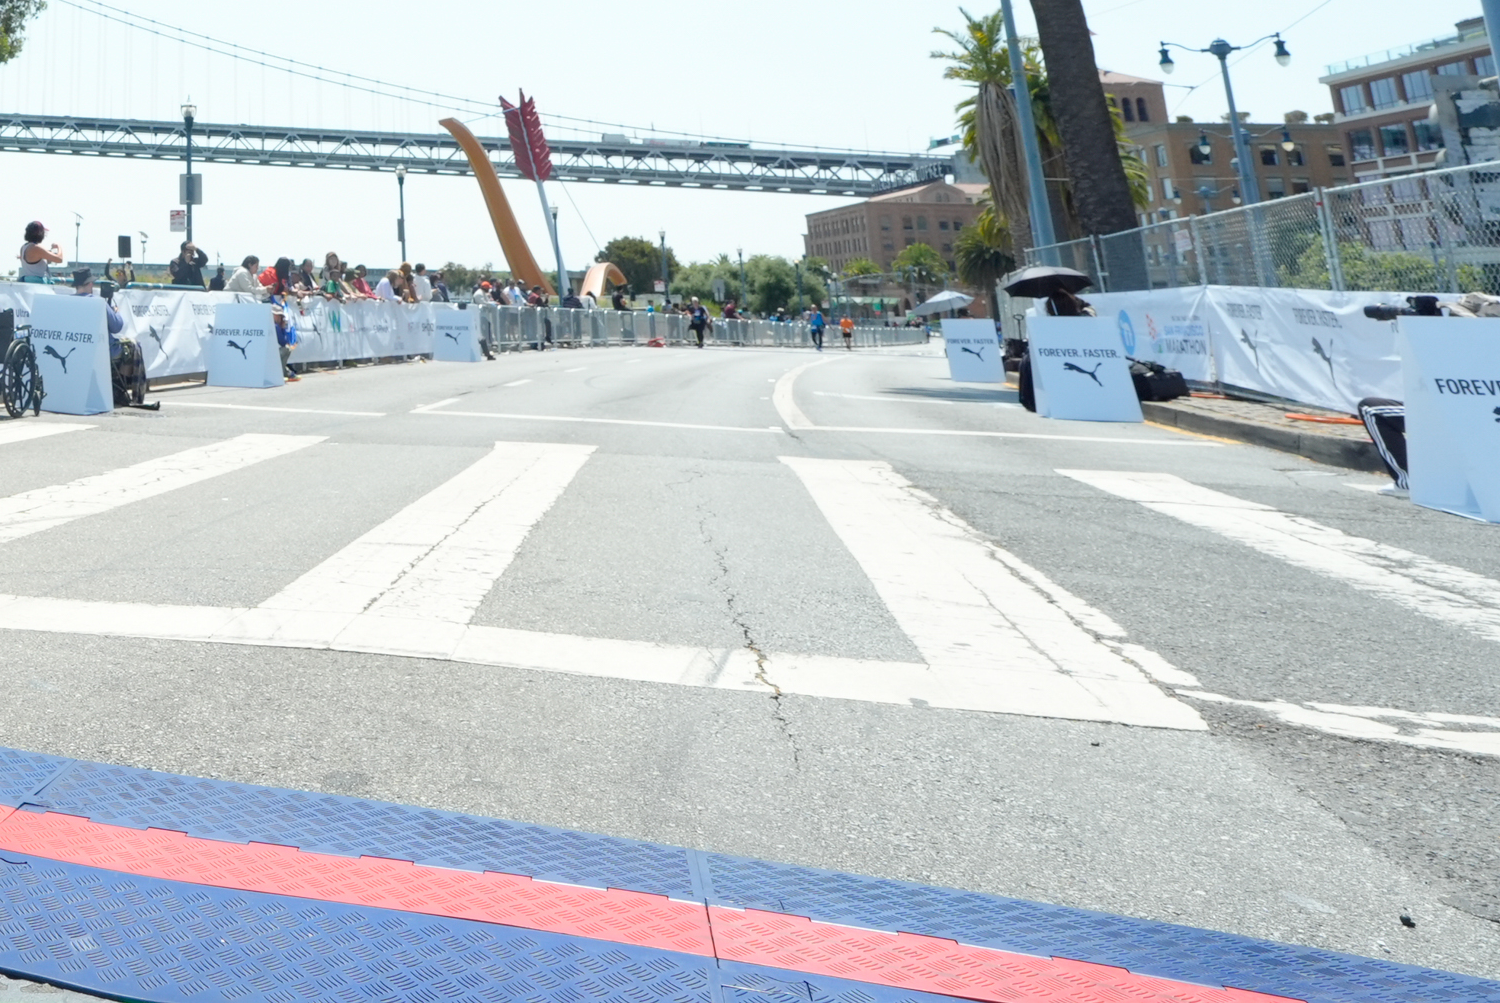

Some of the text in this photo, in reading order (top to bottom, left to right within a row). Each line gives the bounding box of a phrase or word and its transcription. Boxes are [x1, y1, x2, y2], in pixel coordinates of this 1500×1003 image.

[16, 309, 30, 317] Ultra
[30, 328, 63, 341] FOREVER.
[65, 331, 94, 343] FASTER.
[215, 329, 265, 337] FOREVER. FASTER.
[1038, 348, 1121, 358] FOREVER. FASTER.
